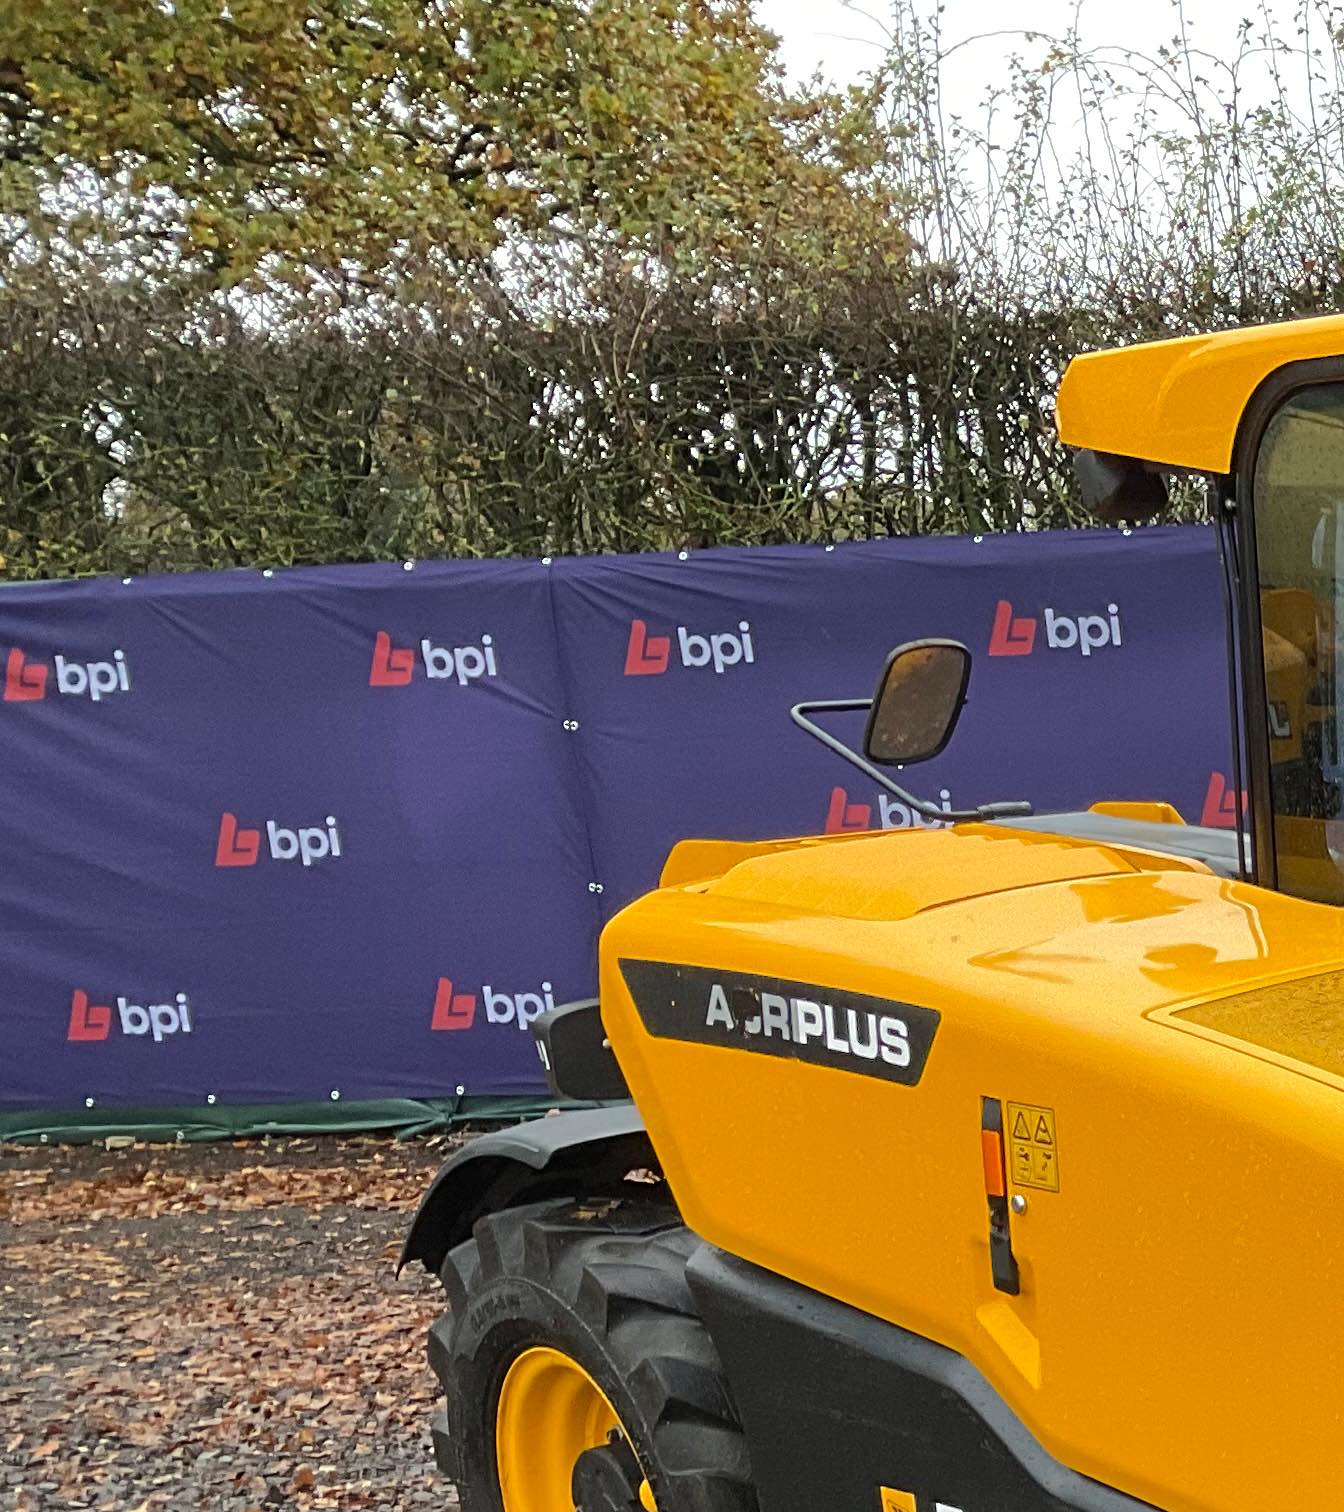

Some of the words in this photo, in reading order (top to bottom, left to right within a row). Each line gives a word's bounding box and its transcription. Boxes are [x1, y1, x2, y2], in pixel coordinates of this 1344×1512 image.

[677, 621, 754, 674] bpi
[1044, 603, 1122, 656] bpi
[54, 649, 130, 701] bpi
[421, 634, 497, 686] bpi
[266, 815, 341, 866] bpi
[117, 993, 191, 1042] bpi
[482, 981, 555, 1031] bpi
[706, 984, 911, 1067] ARIPLUS
